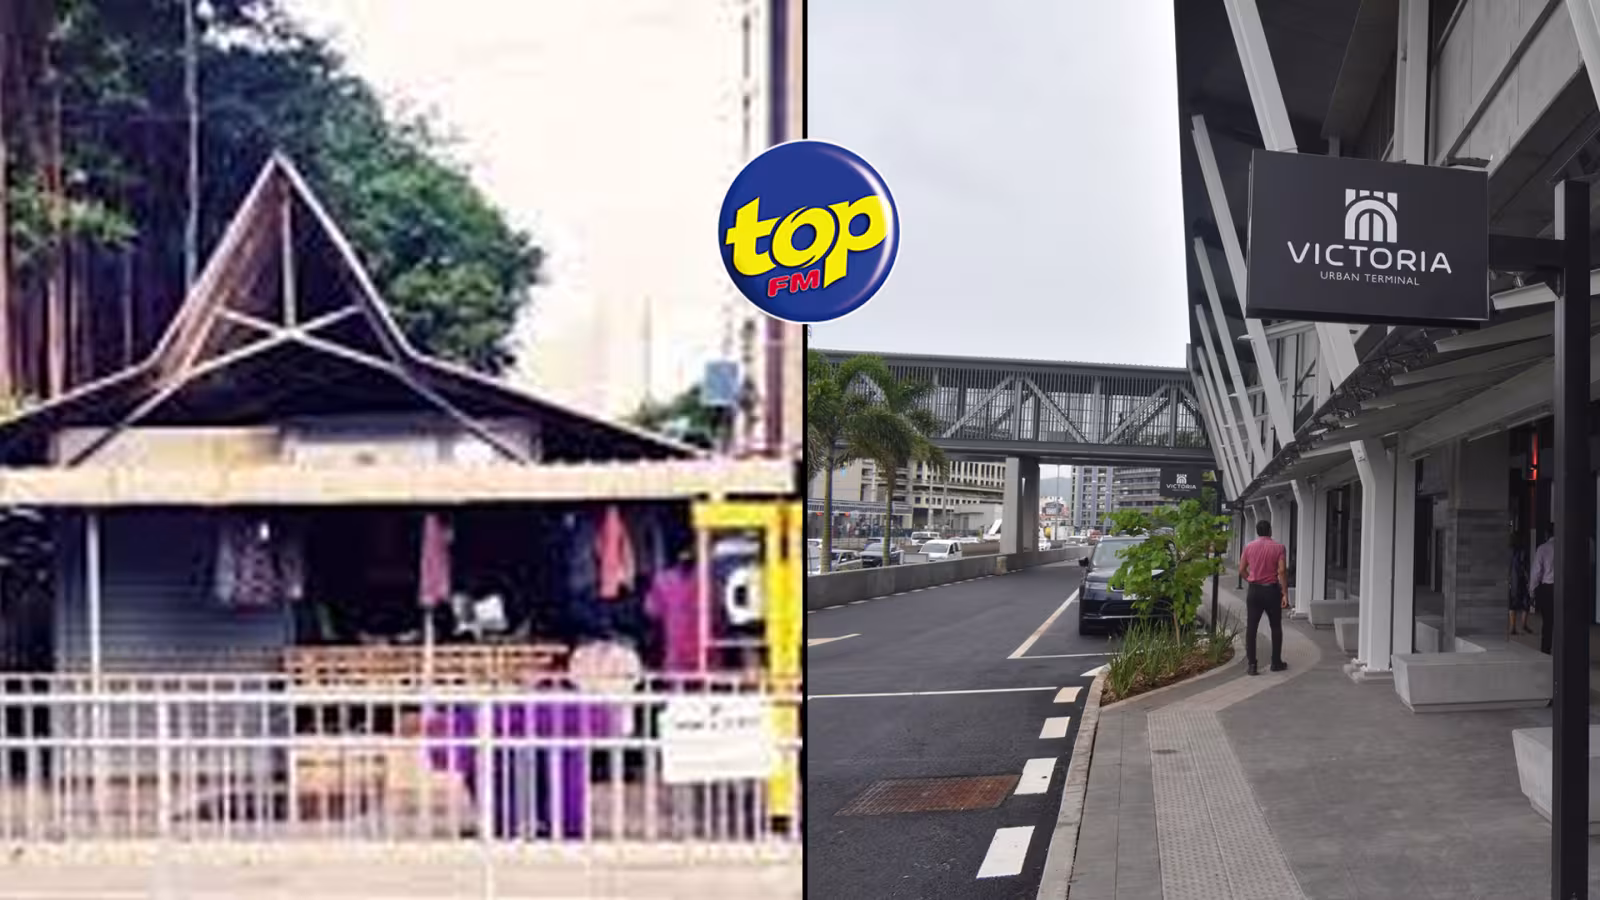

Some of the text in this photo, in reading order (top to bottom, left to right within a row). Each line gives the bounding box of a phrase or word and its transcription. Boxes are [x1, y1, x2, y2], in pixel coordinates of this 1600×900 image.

[1287, 241, 1452, 274] VICTORIA
[1320, 270, 1420, 286] URBAN TERMINAL
